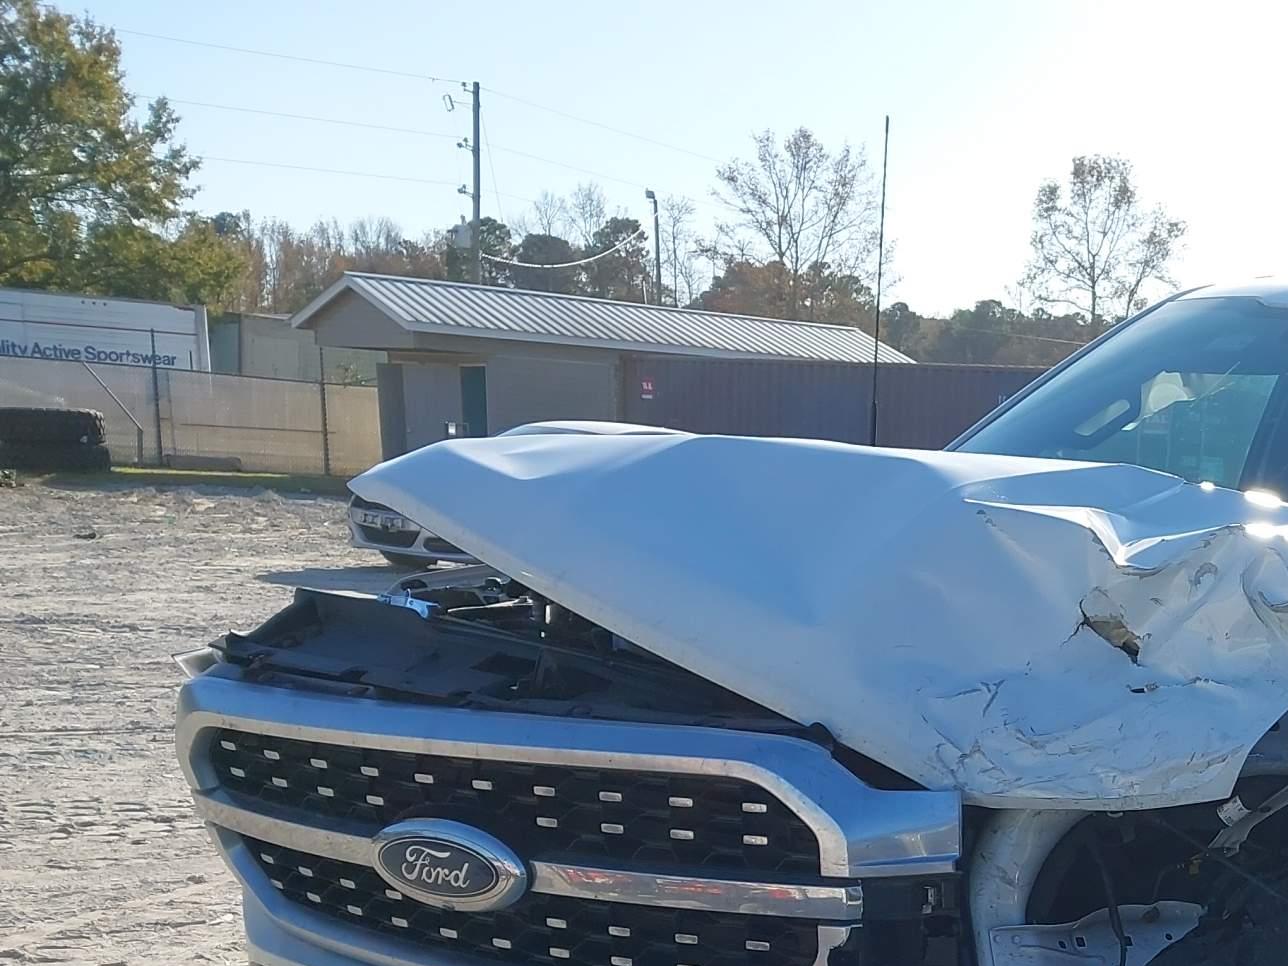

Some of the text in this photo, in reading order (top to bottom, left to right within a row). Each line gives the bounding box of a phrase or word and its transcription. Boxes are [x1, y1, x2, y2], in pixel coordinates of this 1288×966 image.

[0, 339, 177, 367] lity Active Sportswear
[402, 845, 470, 888] Ford
